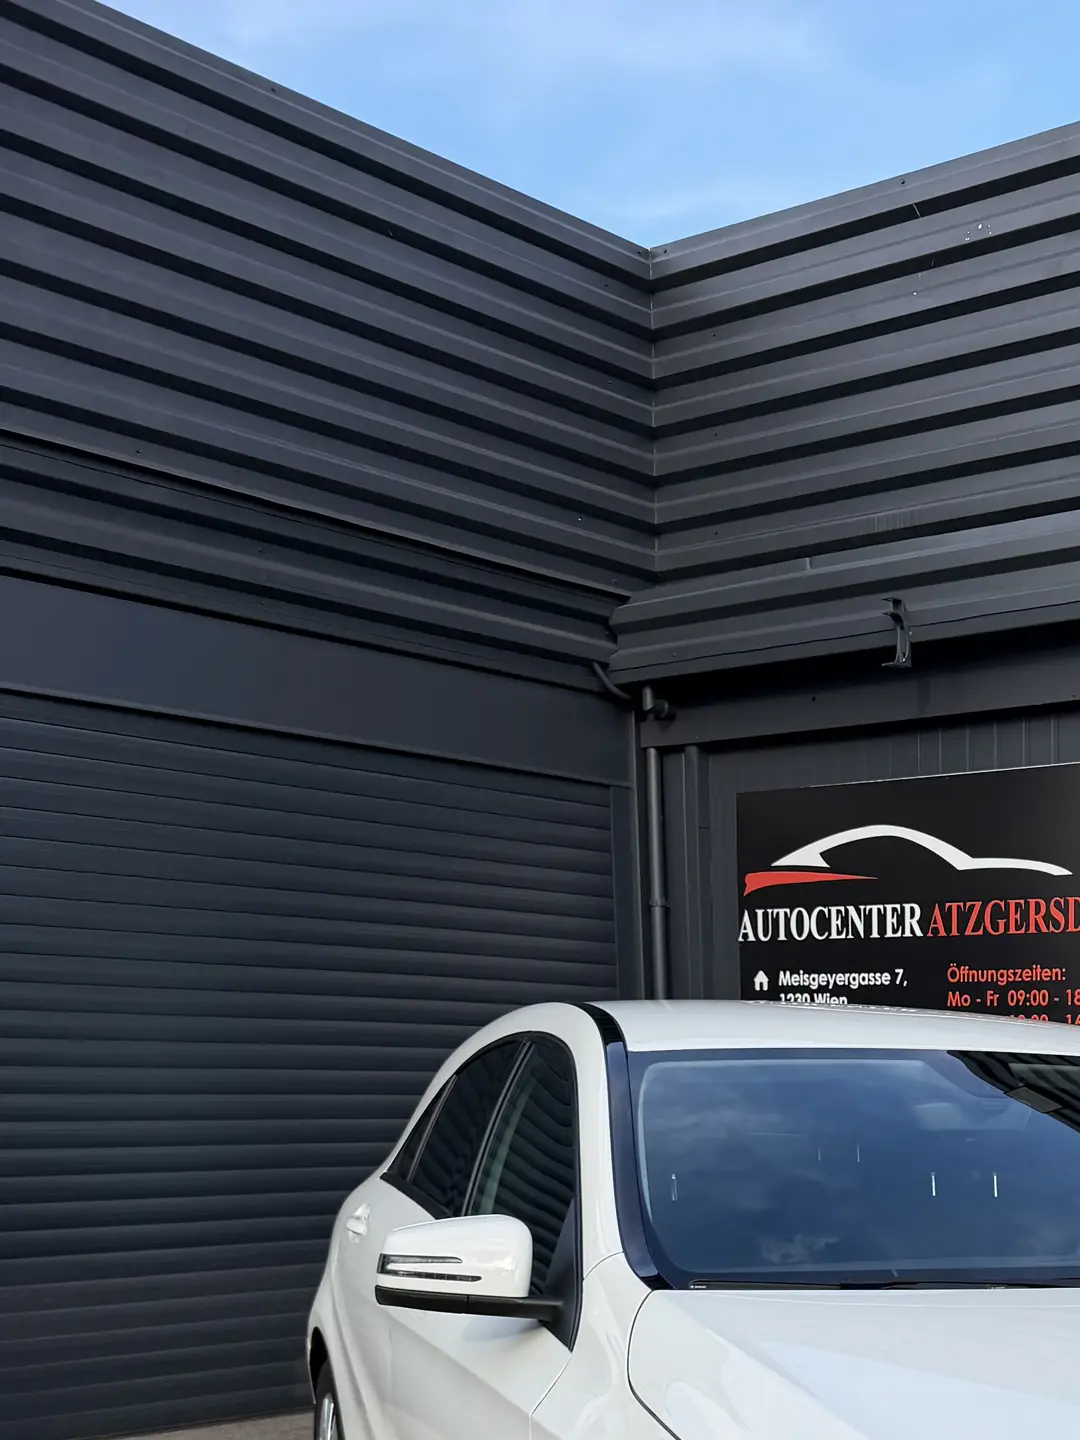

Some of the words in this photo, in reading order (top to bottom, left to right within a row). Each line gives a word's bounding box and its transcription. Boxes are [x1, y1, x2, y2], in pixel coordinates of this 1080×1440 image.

[738, 902, 924, 942] AUTOCENTER
[778, 969, 892, 989] Meisgeyergasse
[894, 968, 908, 987] 7,
[946, 963, 1066, 986] Öffnungszeiten:
[947, 991, 971, 1007] Mo
[986, 990, 1000, 1007] Fr
[1007, 989, 1049, 1007] 09:00
